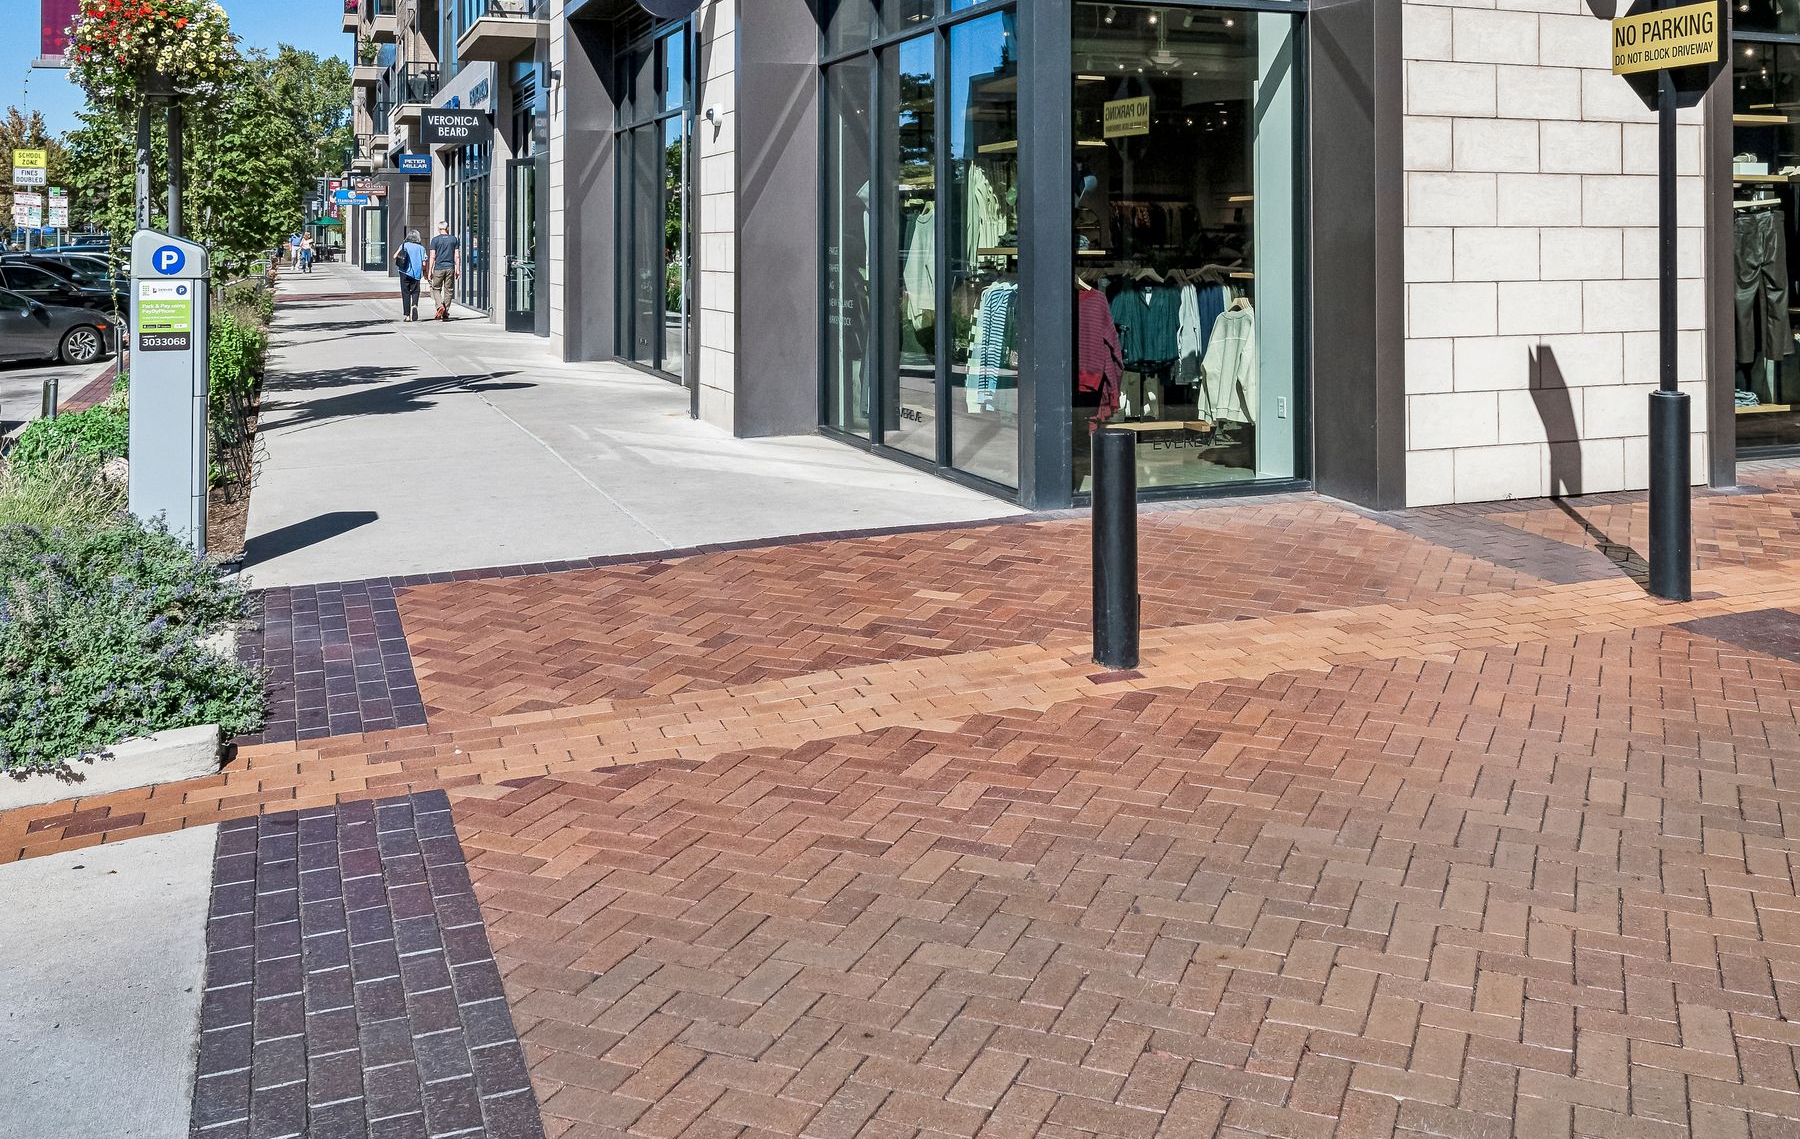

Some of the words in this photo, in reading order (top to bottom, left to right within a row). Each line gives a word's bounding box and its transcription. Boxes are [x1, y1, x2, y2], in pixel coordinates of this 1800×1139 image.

[1615, 24, 1636, 48] NO
[1642, 11, 1713, 43] PARKING
[1615, 54, 1626, 66] DO
[1627, 51, 1642, 64] NOT
[1644, 47, 1670, 62] BLOCK
[1672, 41, 1714, 58] DRIVEWAY
[428, 115, 479, 126] VERONICA
[438, 126, 469, 137] BEARD
[21, 169, 39, 177] FINES
[161, 250, 179, 270] P
[160, 303, 171, 311] Pay
[142, 337, 187, 346] 3033068
